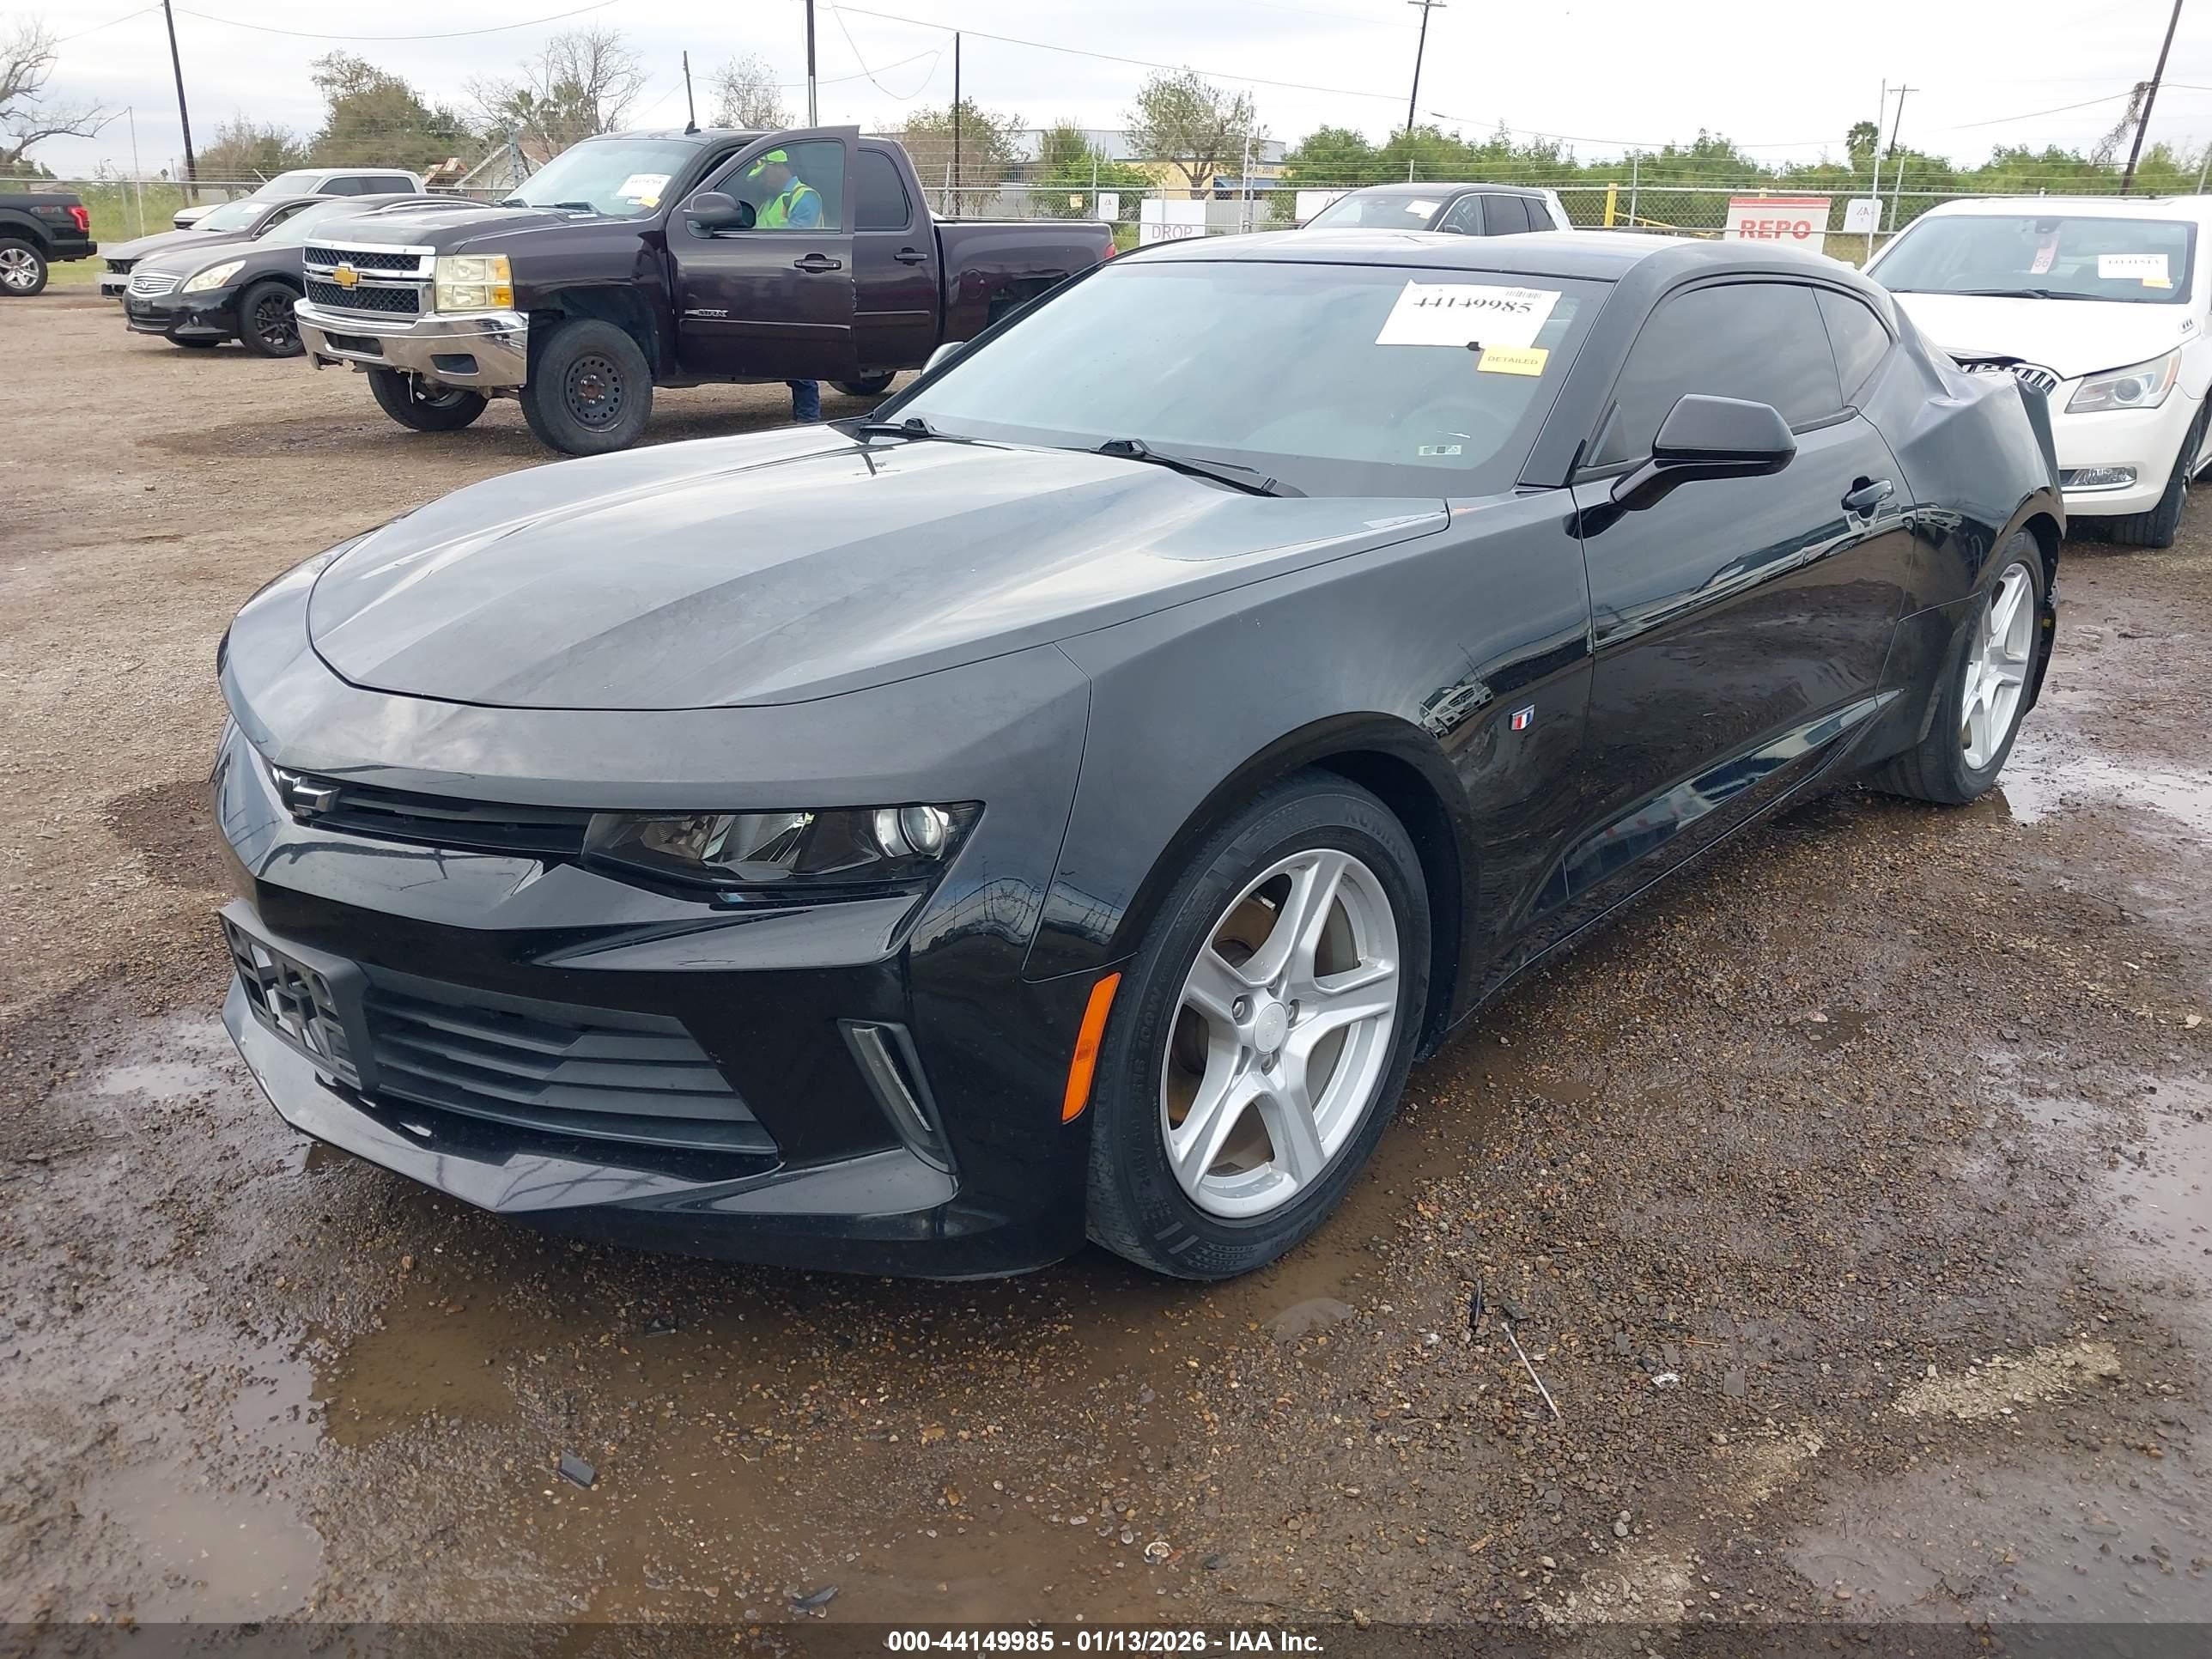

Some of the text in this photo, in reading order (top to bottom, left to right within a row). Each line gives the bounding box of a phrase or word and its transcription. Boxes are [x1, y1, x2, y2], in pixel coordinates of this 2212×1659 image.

[1152, 225, 1193, 240] DROP
[1739, 220, 1812, 240] REPO
[1413, 296, 1534, 313] 44149985
[1487, 355, 1539, 366] DETAILED
